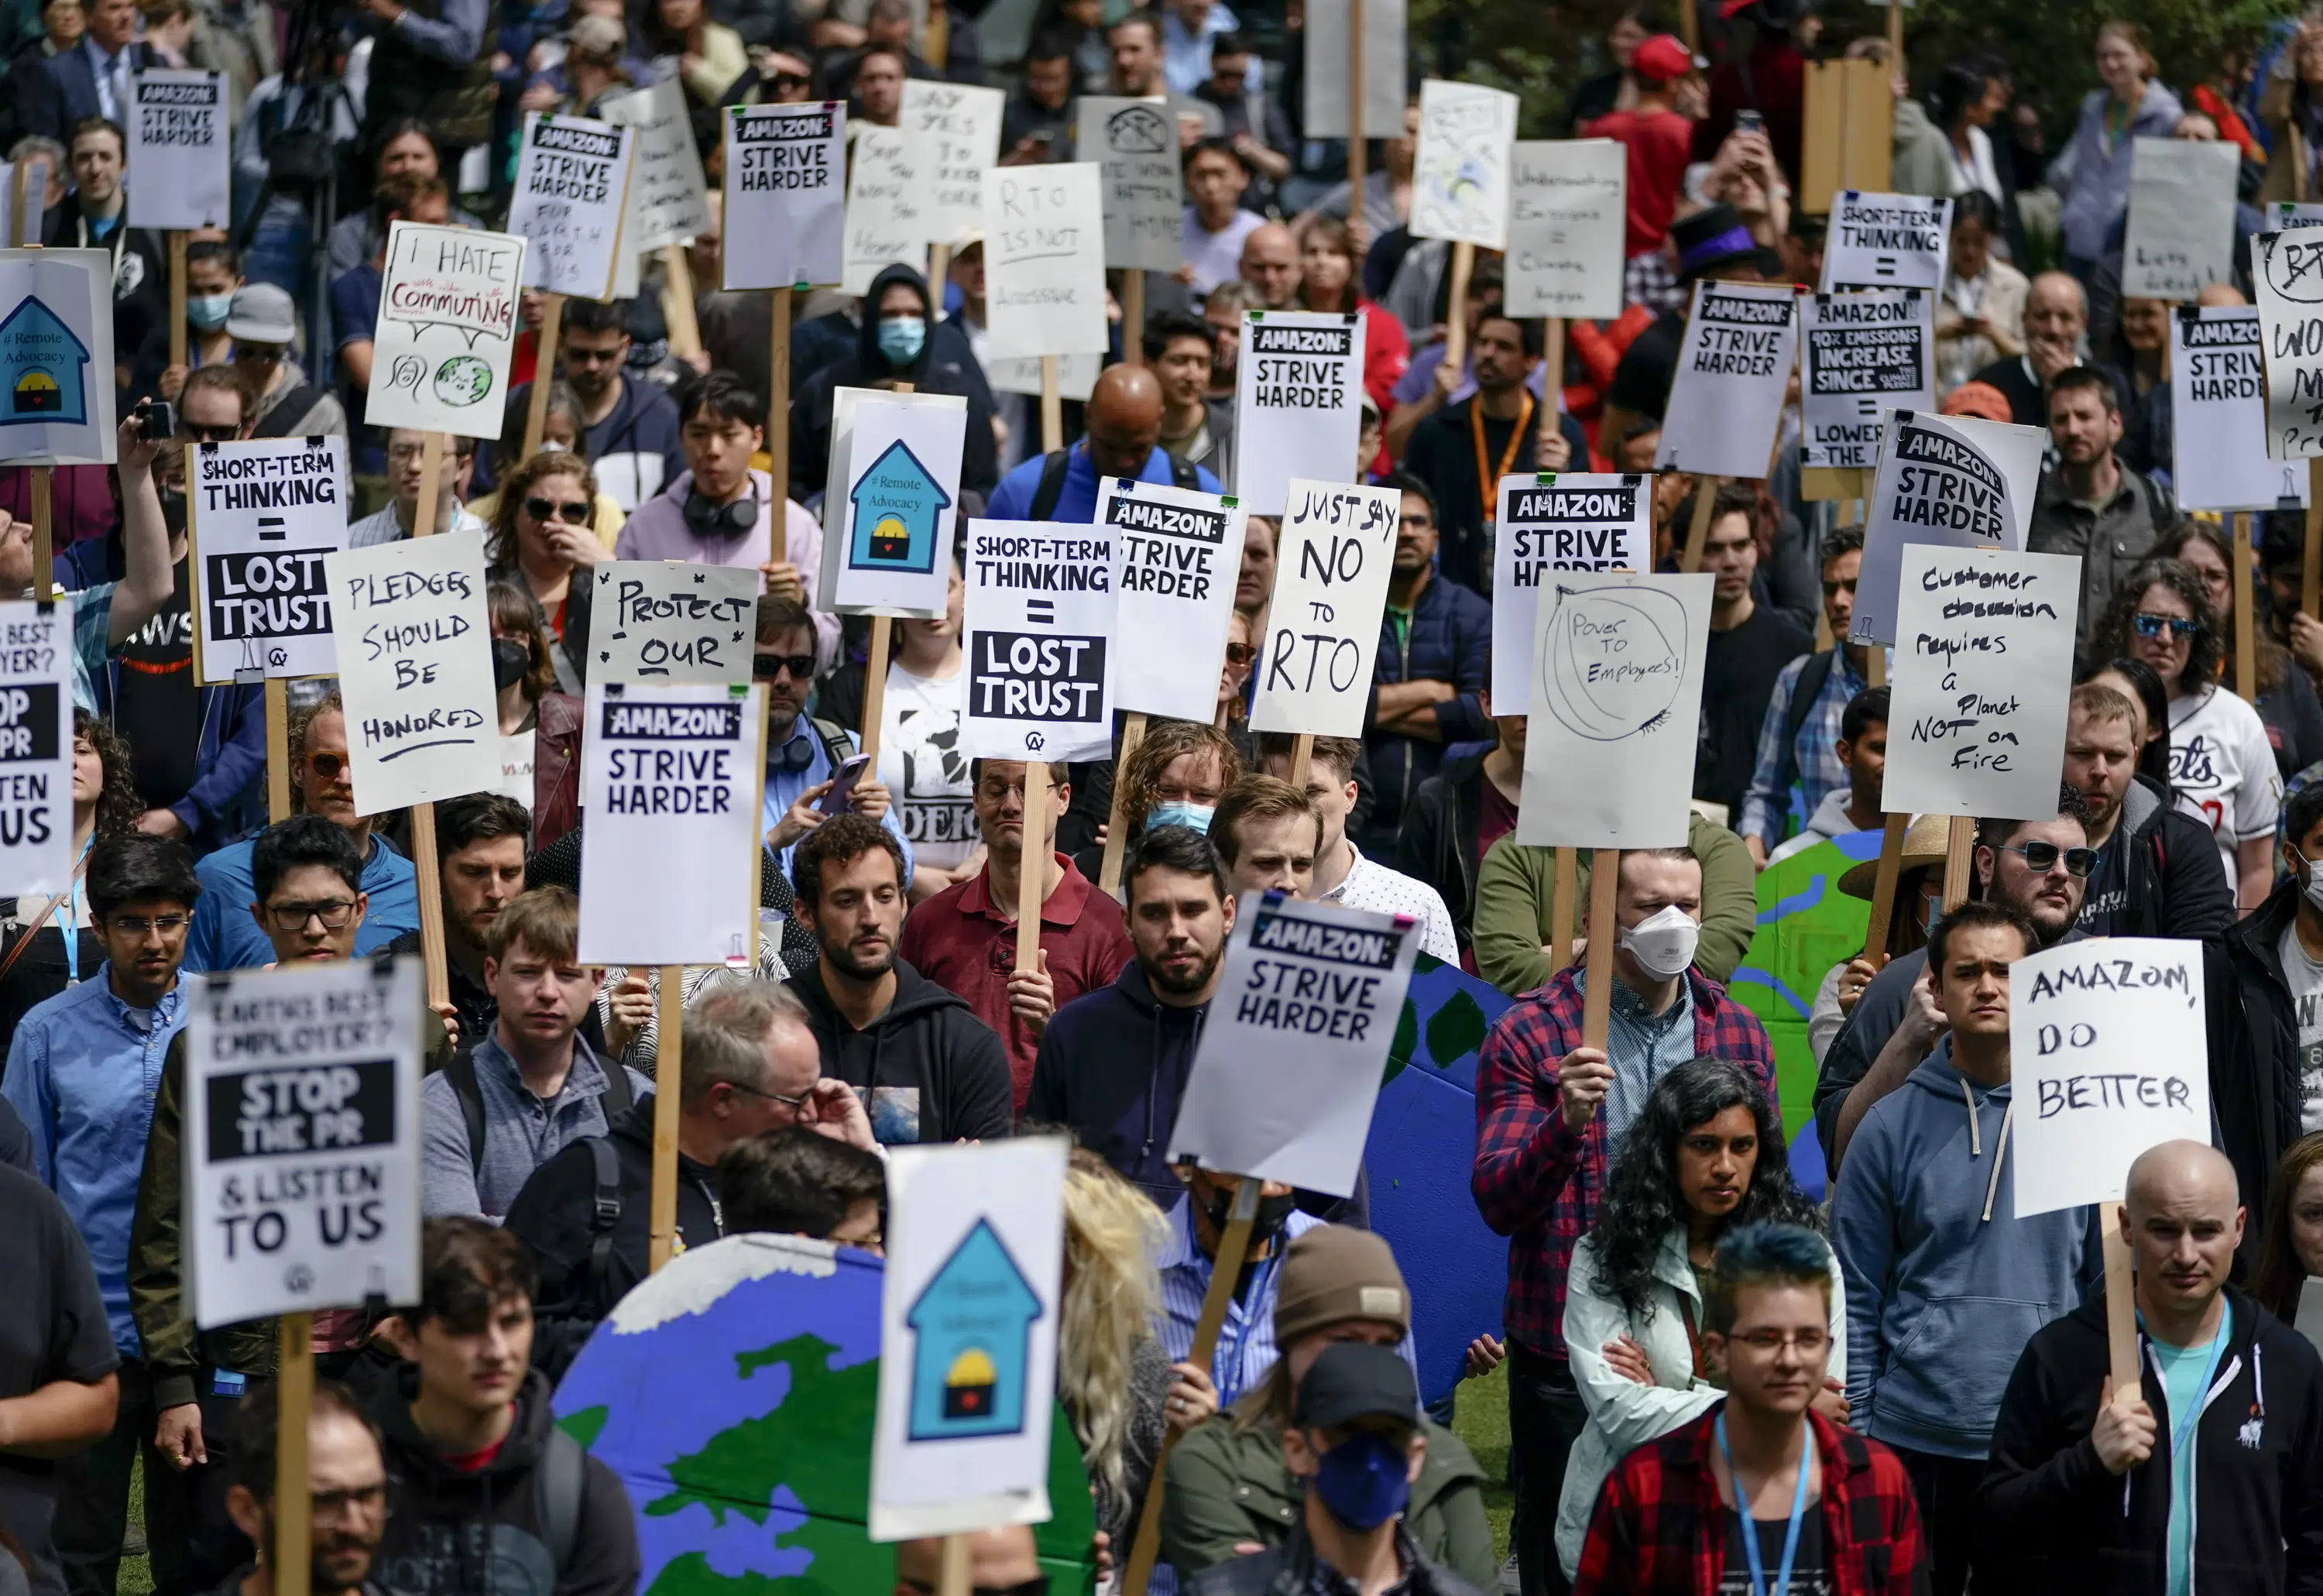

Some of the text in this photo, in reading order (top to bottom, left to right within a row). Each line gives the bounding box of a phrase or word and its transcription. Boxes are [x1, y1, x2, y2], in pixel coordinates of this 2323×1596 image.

[142, 108, 214, 129] STRIVE
[142, 127, 214, 147] HARDER
[533, 153, 612, 184] STRIVE
[741, 144, 829, 170] STRIVE
[529, 176, 609, 205] HARDER
[741, 168, 829, 191] HARDER
[1000, 178, 1068, 218] RTO
[1841, 206, 1942, 228] SHORT-TERM
[1000, 226, 1081, 253] IS NOT
[1841, 225, 1939, 252] THINKING
[411, 236, 514, 283] I HATE
[15, 331, 63, 346] Remote
[1699, 327, 1781, 355] STRIVE
[1844, 328, 1920, 347] EMISSIONS
[3, 349, 67, 366] Advocacy
[1257, 359, 1345, 386] STRIVE
[1694, 351, 1776, 377] HARDER
[1818, 345, 1914, 369] INCREASE
[1816, 369, 1877, 392] SINCE
[1255, 386, 1344, 409] HARDER
[202, 451, 335, 481] SHORT-TERM
[1824, 445, 1867, 465] THE
[1906, 433, 2001, 490] AMAZON:
[203, 477, 336, 511] THINKING
[879, 475, 921, 492] Remote
[1897, 466, 2003, 520] STRIVE
[867, 494, 922, 513] Advocacy
[1293, 489, 1396, 544] JUST SAY
[1516, 493, 1628, 518] AMAZON:
[1892, 495, 2003, 541] HARDER
[1114, 505, 1220, 538] AMAZON:
[975, 536, 1111, 562] SHORT-TERM
[1513, 528, 1629, 558] STRIVE
[220, 552, 324, 596] LOST
[1300, 534, 1364, 588] NO
[347, 571, 472, 611] PLEDGES
[975, 561, 1110, 593] THINKING
[1120, 565, 1210, 601] ARDER
[1922, 565, 2038, 592] Customer
[214, 593, 331, 637] TRUST
[618, 579, 752, 629] PROTECT
[1309, 601, 1335, 623] TO
[1942, 598, 2058, 621] obsession
[7, 622, 55, 647] BEST
[362, 615, 471, 661] SHOULD
[1600, 638, 1628, 654] TO
[1916, 630, 2008, 669] requires
[640, 637, 725, 669] OUR
[987, 634, 1091, 678] LOST
[1267, 628, 1360, 693] RTO
[395, 659, 441, 692] BE
[976, 675, 1100, 719] TRUST
[1956, 693, 2022, 717] Planet
[362, 709, 486, 749] HONORED
[611, 706, 735, 736] AMAZON:
[1911, 717, 2019, 747] NOT on
[609, 749, 732, 781] STRIVE
[1950, 746, 2015, 773] Fire
[607, 785, 732, 815] HARDER
[1, 805, 52, 847] US
[1260, 920, 1391, 965] AMAZON:
[1246, 959, 1381, 1010] STRIVE
[326, 989, 389, 1016] BEST
[1237, 994, 1371, 1042] HARDER
[211, 1018, 396, 1061] EMPLOYER?
[2037, 1023, 2098, 1056] DO
[238, 1066, 362, 1120] STOP
[2037, 1073, 2194, 1120] BETTER
[235, 1110, 366, 1155] THE PR
[218, 1165, 384, 1210] & LISTEN
[216, 1200, 386, 1262] TO US
